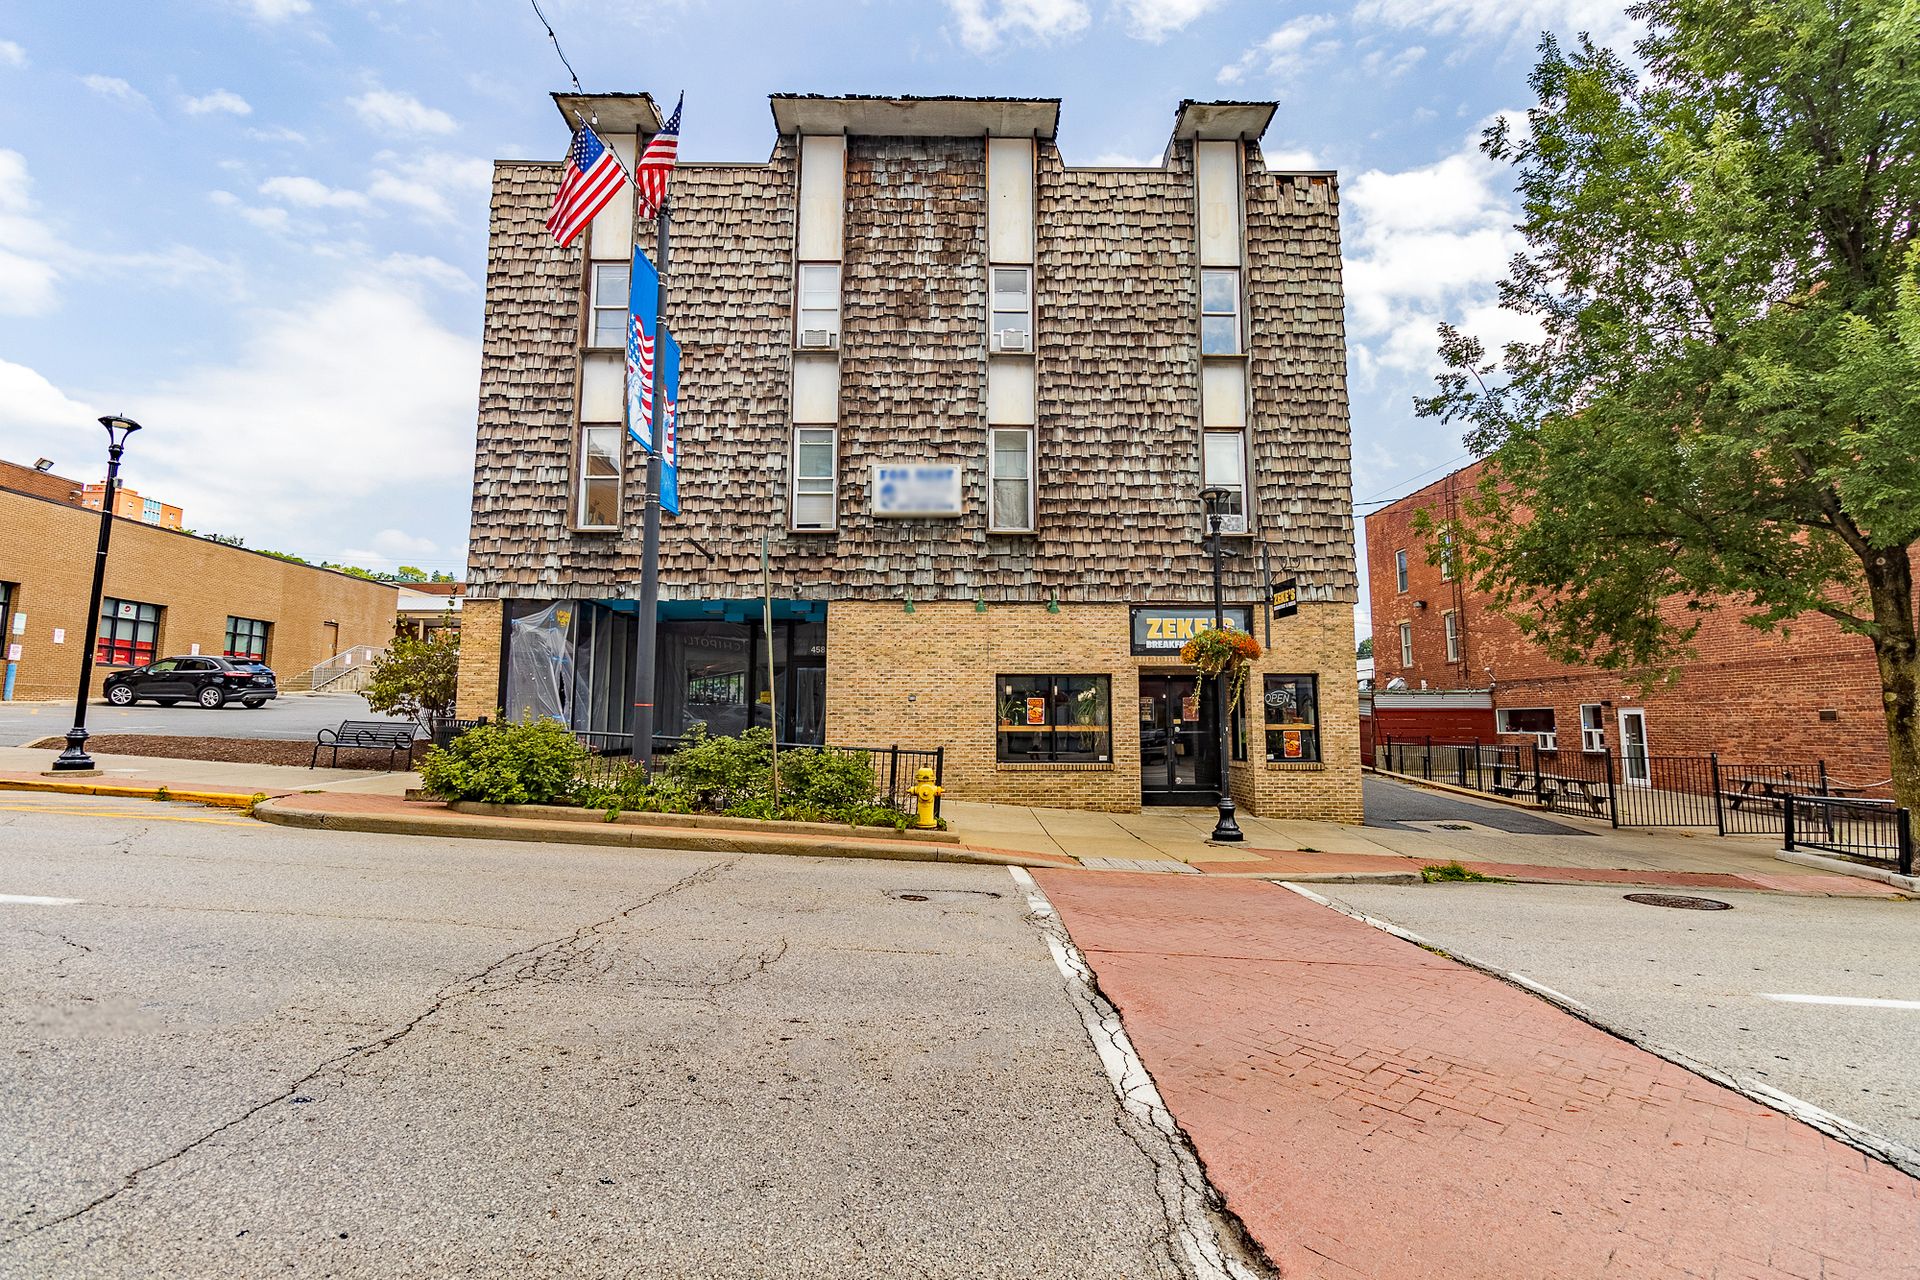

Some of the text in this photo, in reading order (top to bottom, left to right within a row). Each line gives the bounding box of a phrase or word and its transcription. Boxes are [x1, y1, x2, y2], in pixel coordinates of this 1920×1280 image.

[1273, 587, 1295, 606] ZEKE'S
[1146, 640, 1189, 649] BREAKFA
[1265, 693, 1290, 703] OPEN
